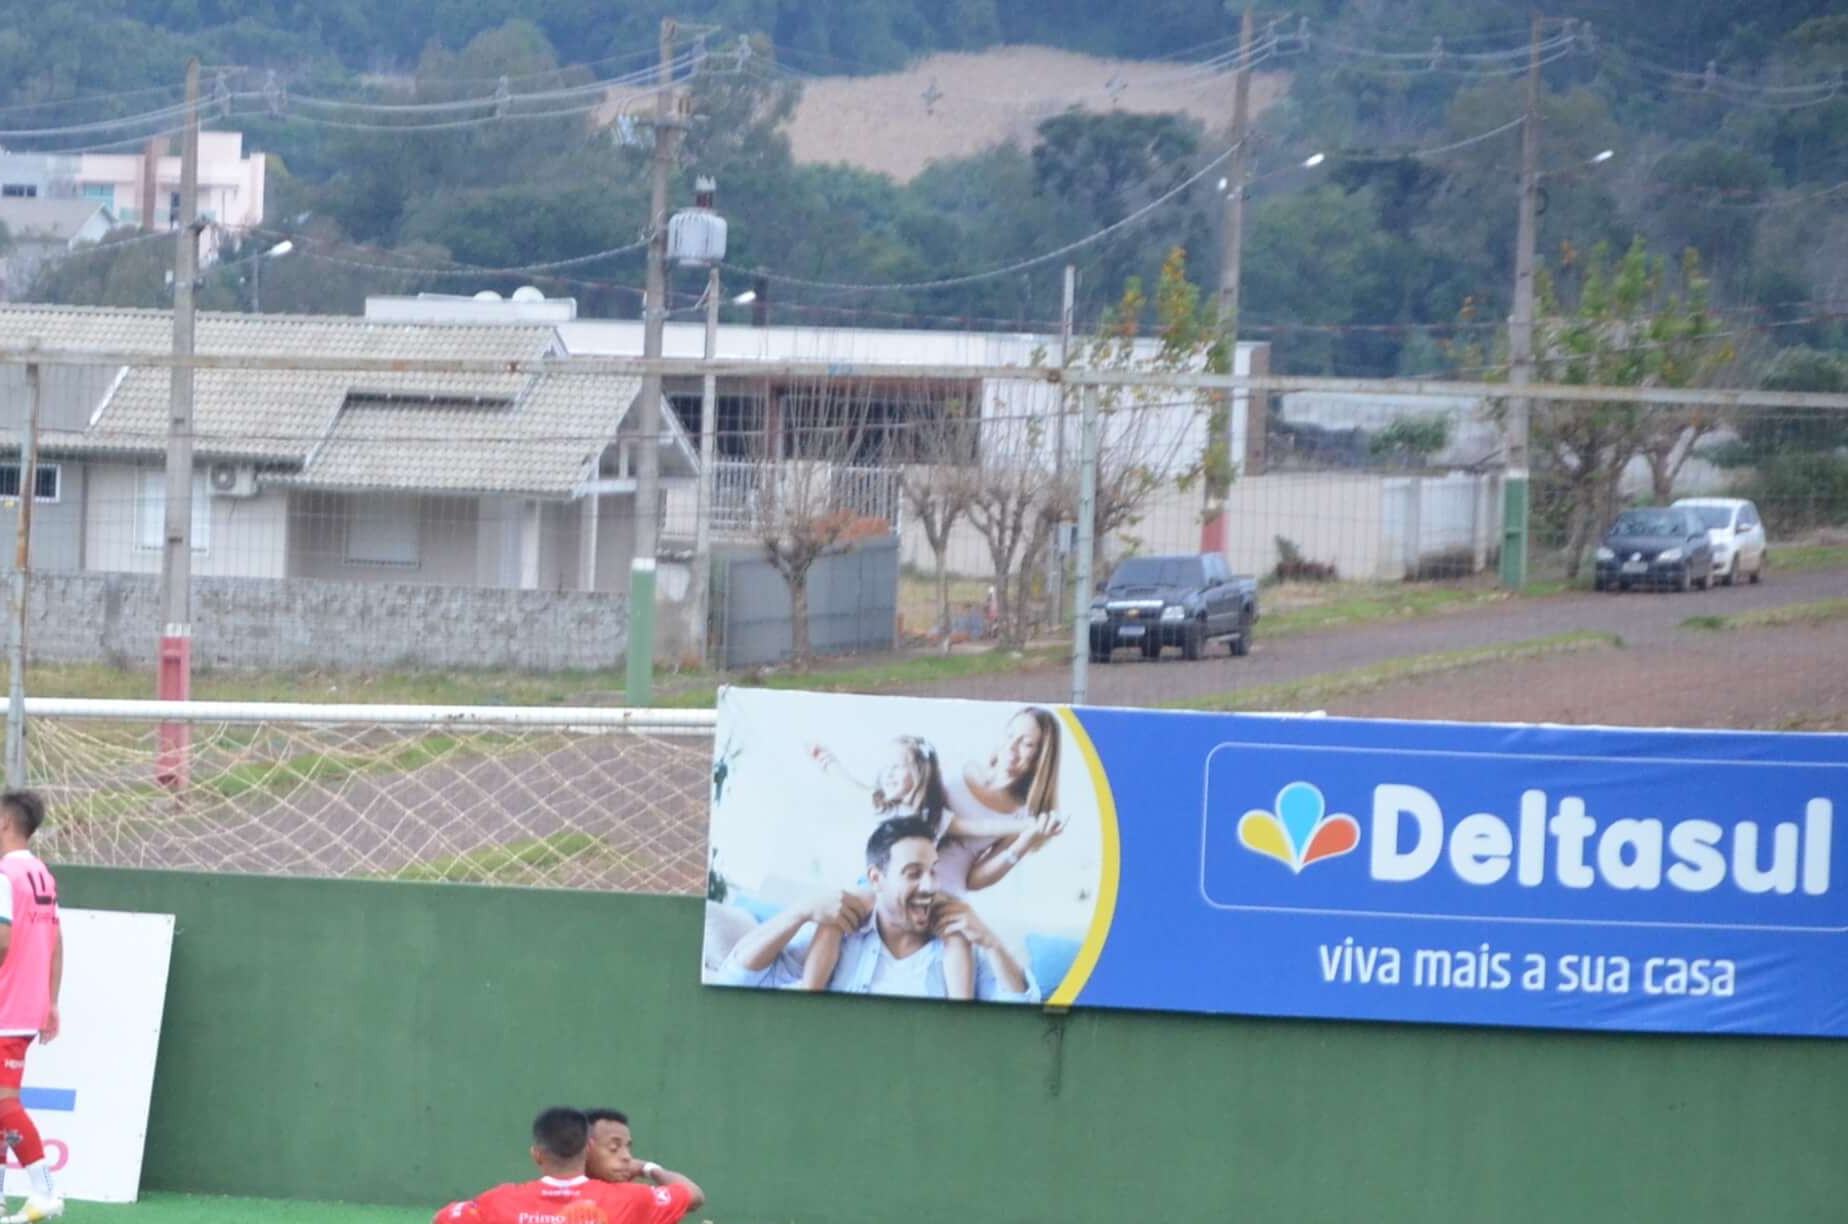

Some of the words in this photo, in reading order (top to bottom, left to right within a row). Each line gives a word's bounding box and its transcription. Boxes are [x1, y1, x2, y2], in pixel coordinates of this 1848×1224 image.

[1370, 783, 1833, 895] Deltasul
[1320, 937, 1401, 984] viva
[1414, 943, 1511, 989] mais
[1522, 954, 1546, 990] a
[1558, 955, 1630, 993] sua
[1643, 957, 1735, 997] casa
